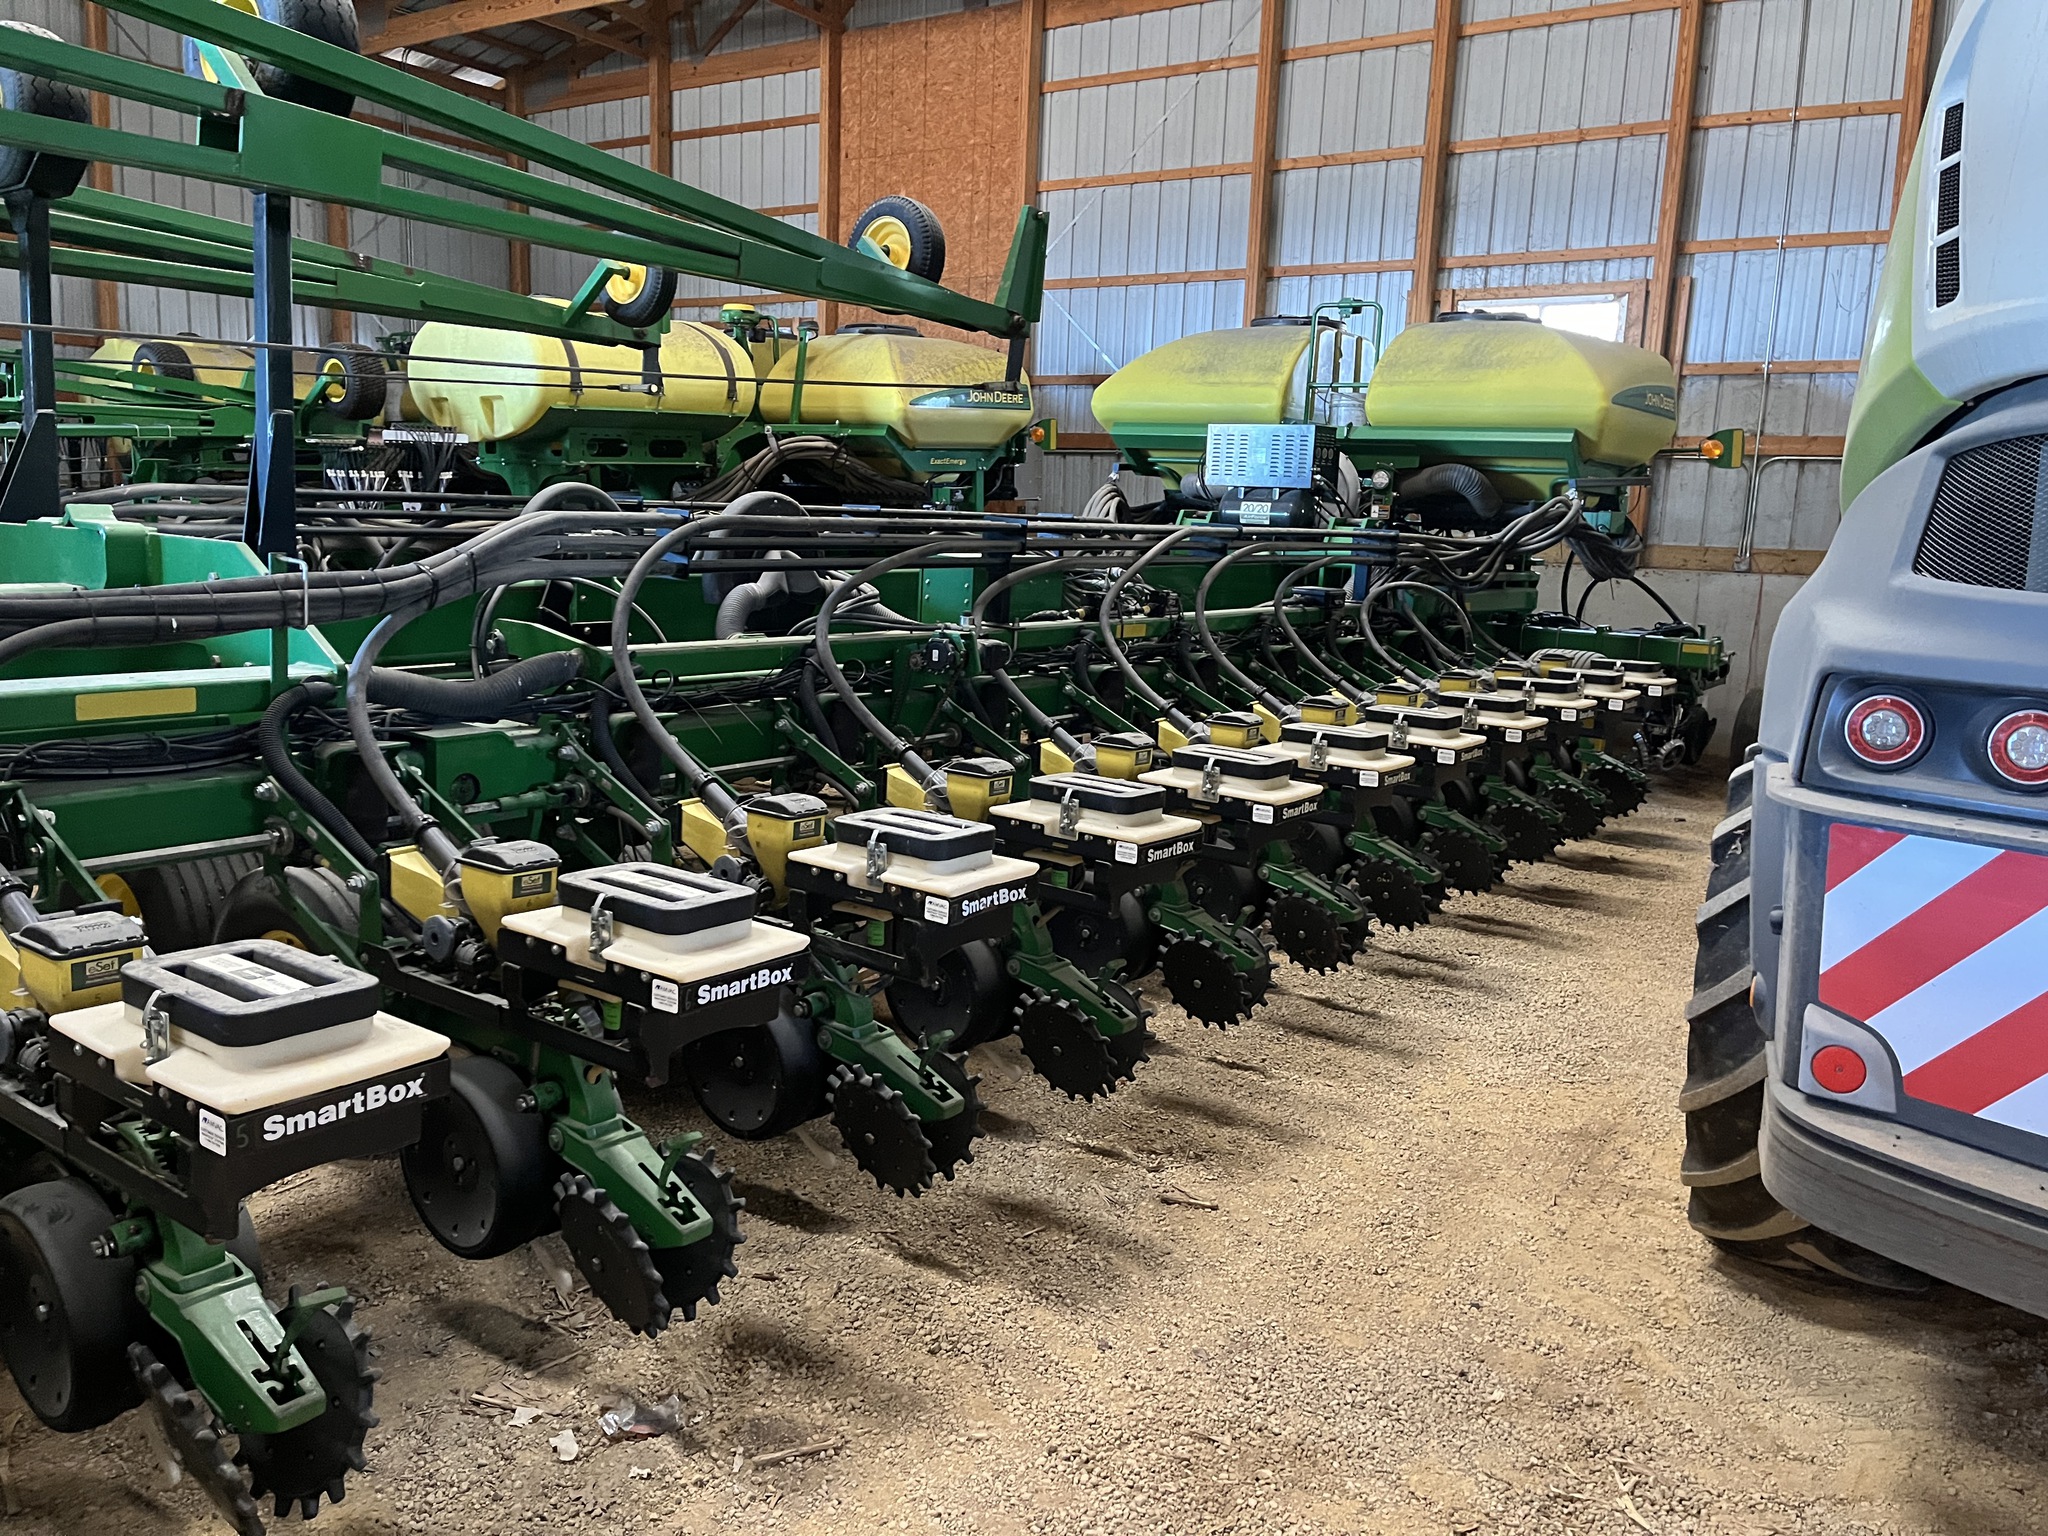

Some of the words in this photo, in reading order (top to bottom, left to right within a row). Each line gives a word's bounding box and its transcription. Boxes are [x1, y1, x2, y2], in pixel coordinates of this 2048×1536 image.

[967, 390, 994, 403] JOHN
[994, 391, 1024, 404] DEERE
[1243, 503, 1269, 513] 20/20
[1384, 771, 1411, 786] SmartBox
[1282, 801, 1319, 820] SmartBox
[1147, 840, 1195, 862] SmartBox
[961, 886, 1027, 917] SmartBox
[697, 966, 793, 1005] SmartBox
[262, 1075, 426, 1142] SmartBox
[236, 1123, 250, 1149] 5
